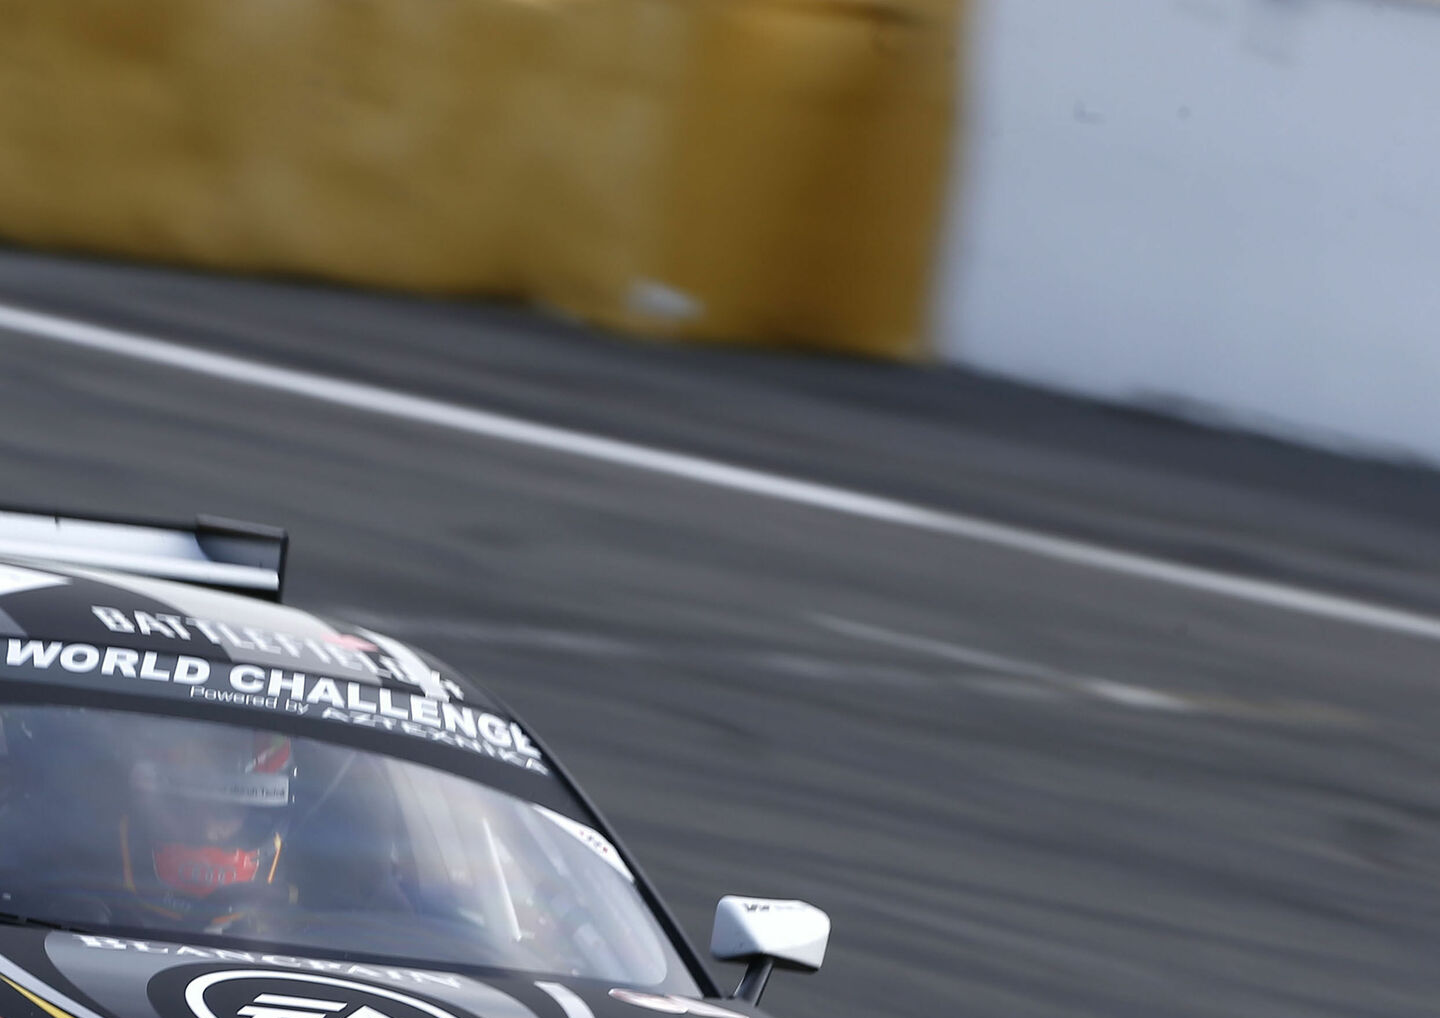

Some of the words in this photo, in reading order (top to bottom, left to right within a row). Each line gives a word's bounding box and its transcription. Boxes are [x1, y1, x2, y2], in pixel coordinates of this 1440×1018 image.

[6, 638, 210, 685] WORLD
[190, 686, 278, 710] Powered
[285, 700, 310, 716] by
